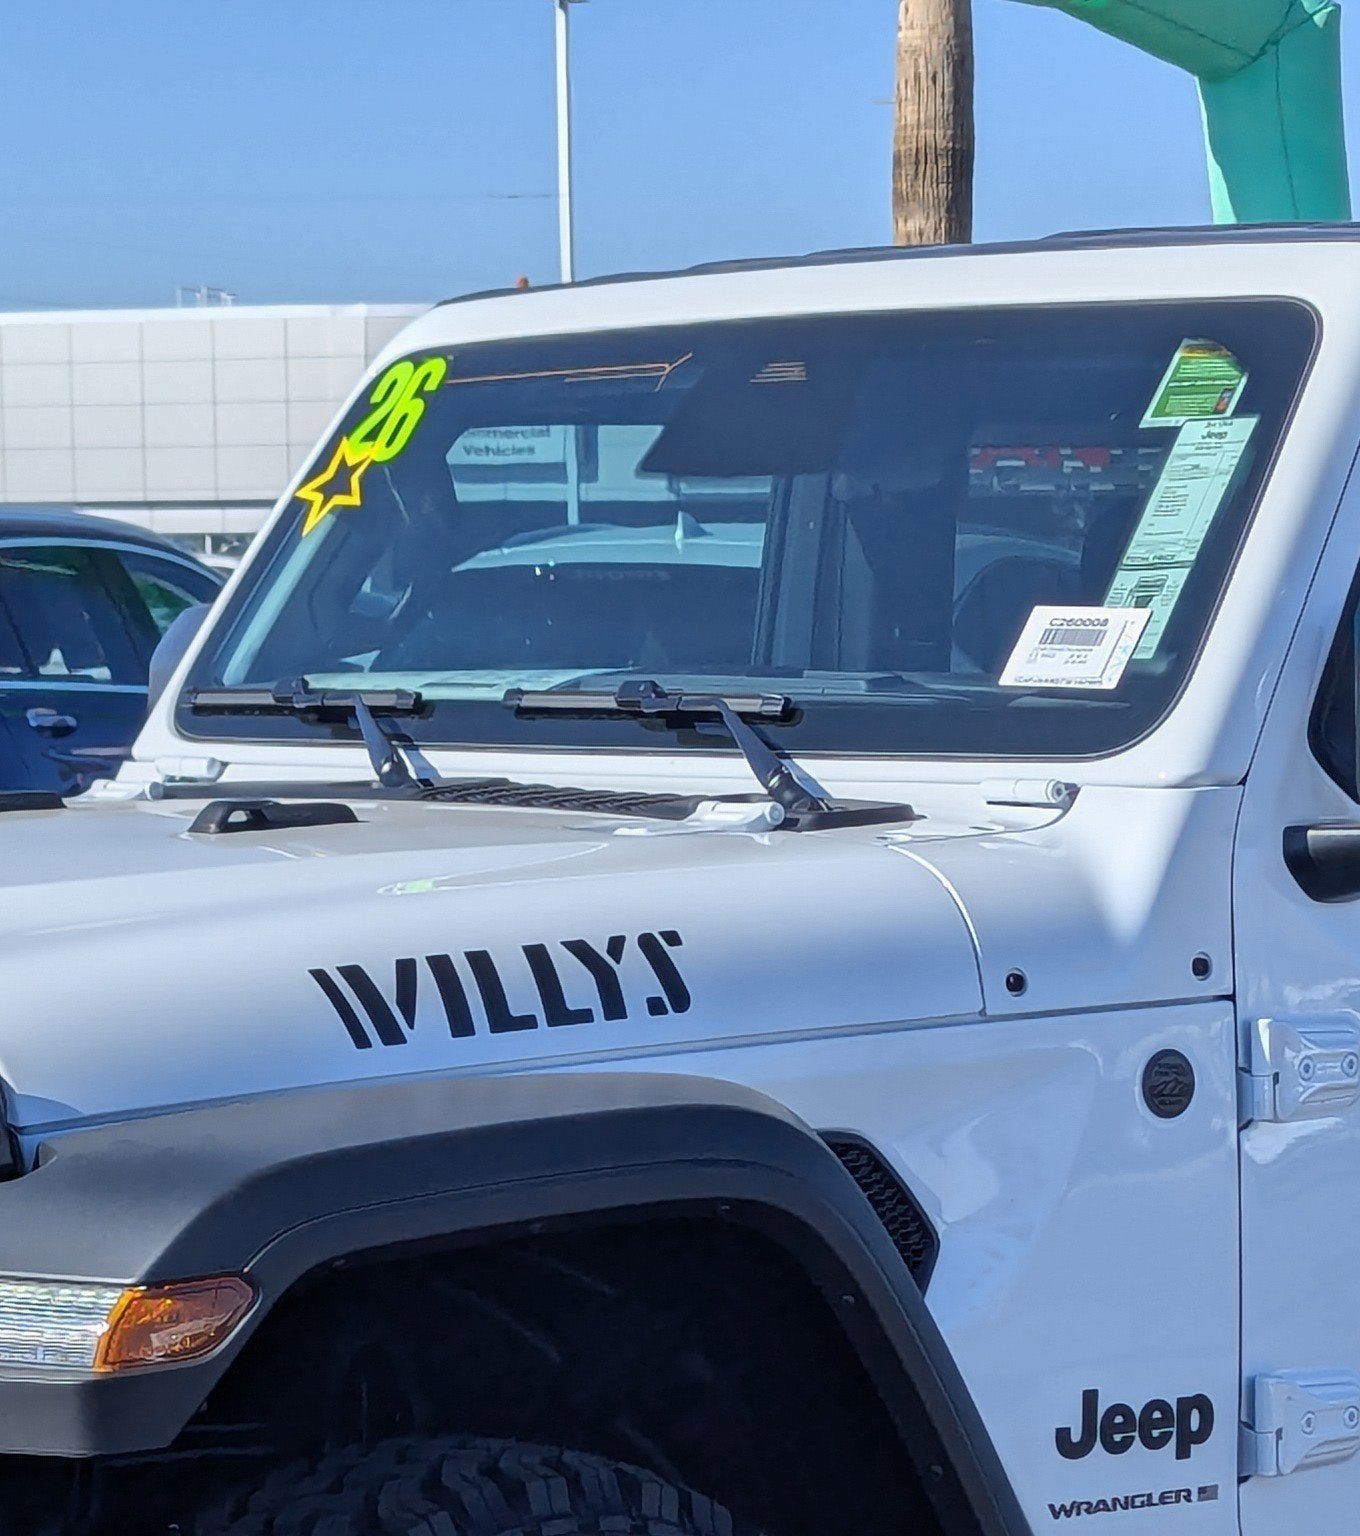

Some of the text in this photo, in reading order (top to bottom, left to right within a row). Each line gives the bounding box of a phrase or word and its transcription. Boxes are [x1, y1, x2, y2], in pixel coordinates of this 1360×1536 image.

[346, 356, 448, 463] 26
[307, 929, 692, 1051] WILLYS
[1054, 1388, 1216, 1461] Jeep
[1046, 1488, 1194, 1521] WRANGLER
